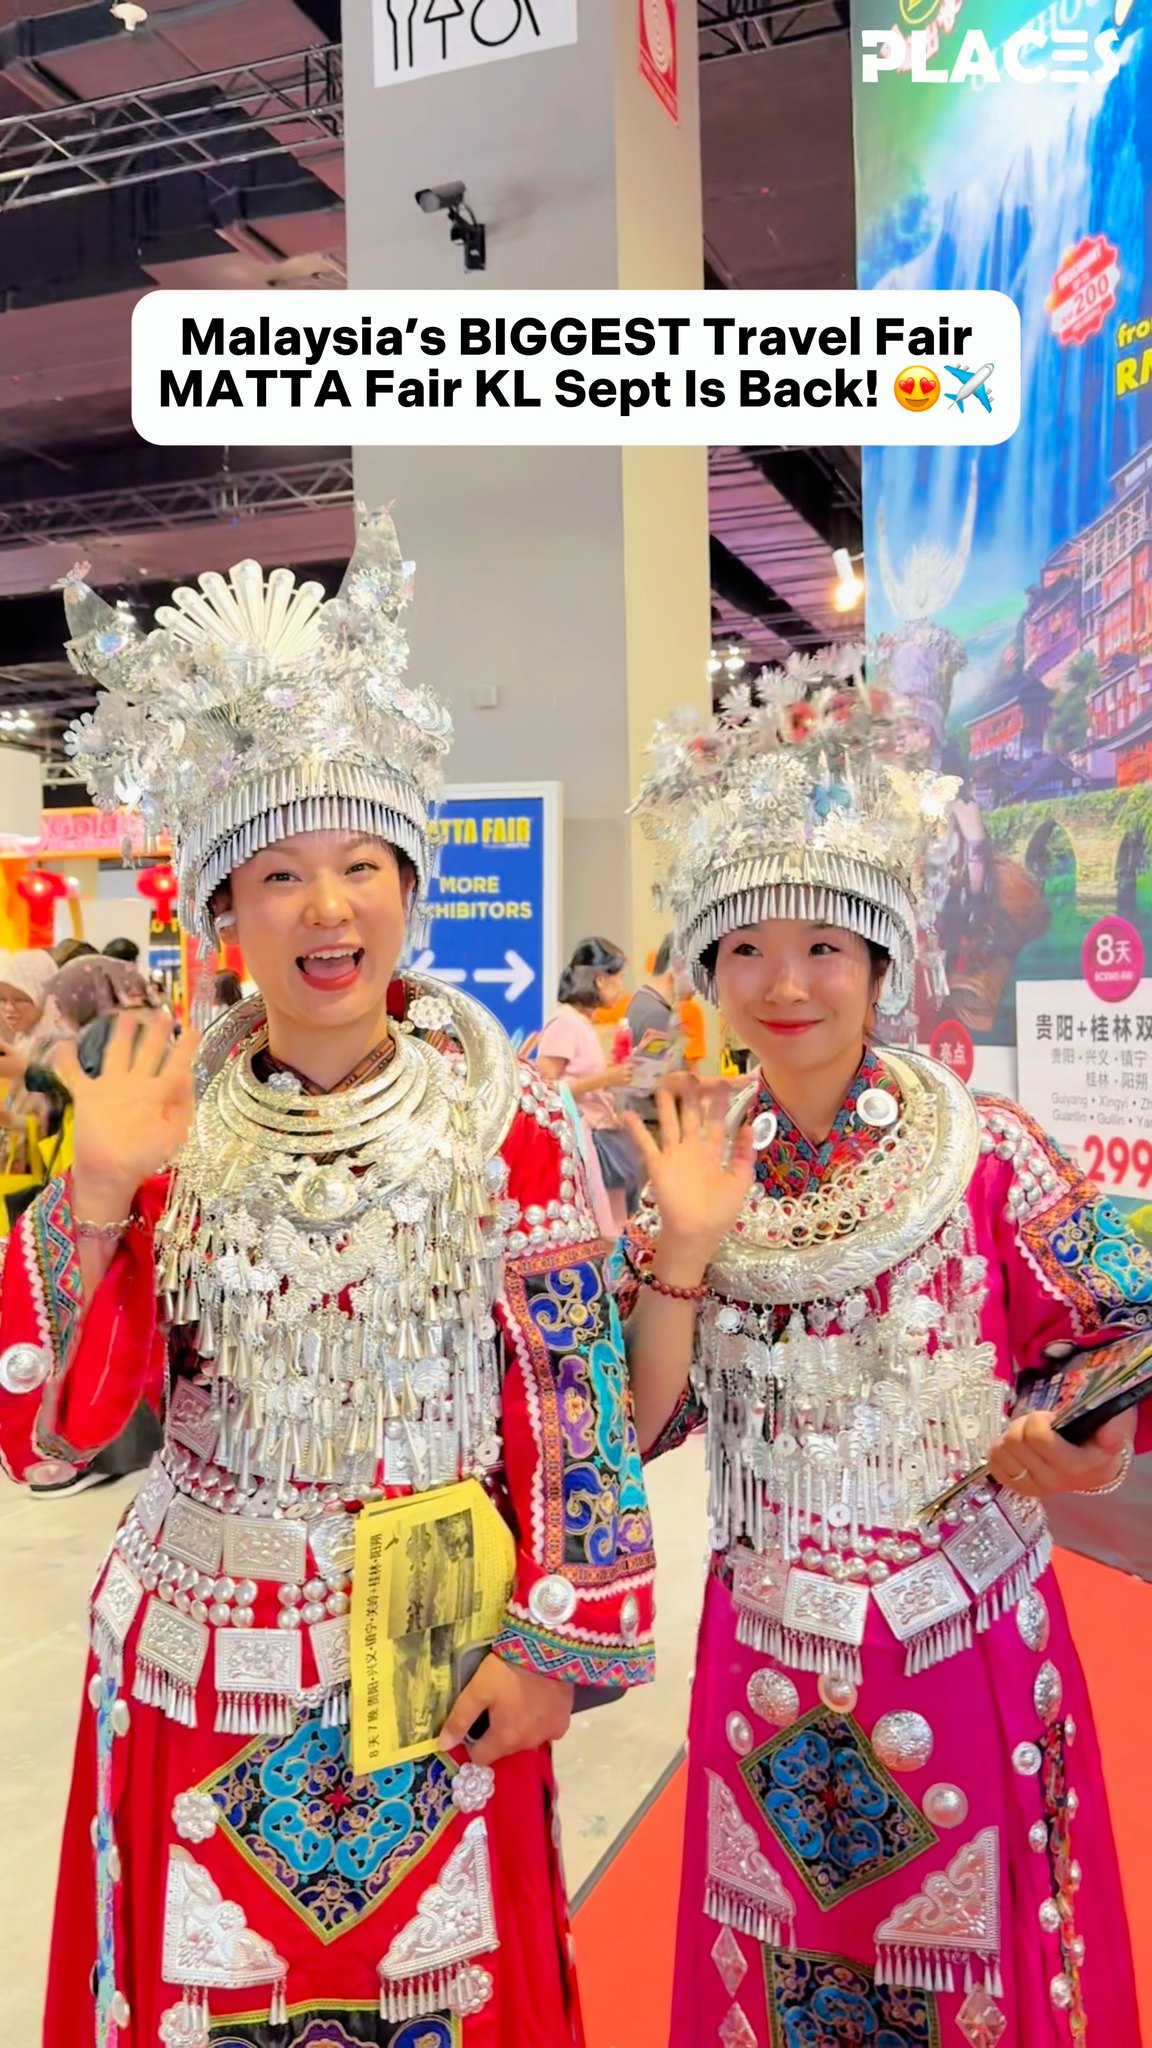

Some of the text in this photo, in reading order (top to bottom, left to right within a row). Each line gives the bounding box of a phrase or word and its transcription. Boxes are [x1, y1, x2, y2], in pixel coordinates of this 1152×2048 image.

[1074, 273, 1109, 314] 200
[1117, 317, 1152, 349] fro
[481, 817, 531, 844] FAIR
[440, 876, 501, 894] MORE
[1095, 933, 1132, 967] 8天
